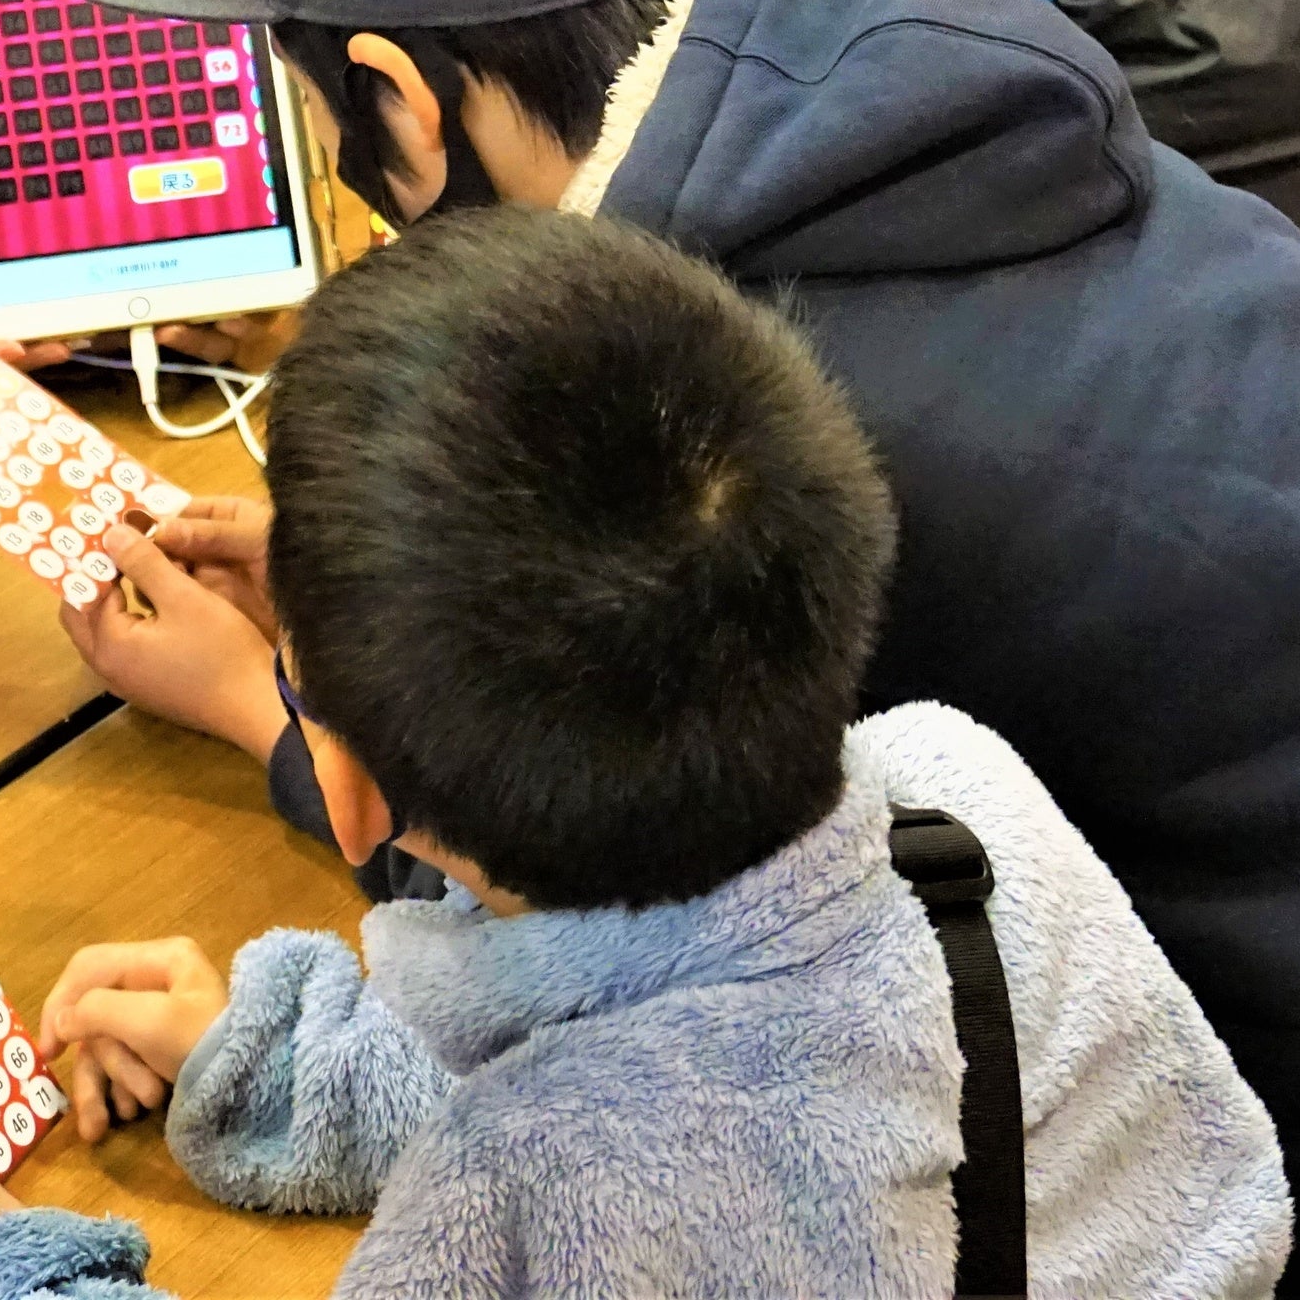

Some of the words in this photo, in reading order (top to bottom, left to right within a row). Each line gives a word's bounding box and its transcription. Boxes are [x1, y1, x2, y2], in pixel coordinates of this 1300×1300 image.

[222, 123, 242, 137] 72
[161, 173, 195, 191] 戻る
[15, 463, 33, 479] 38
[37, 442, 53, 456] 48
[56, 421, 73, 437] 73
[5, 532, 22, 547] 13
[27, 510, 43, 525] 18
[69, 466, 85, 480] 46
[89, 446, 104, 460] 71
[40, 559, 52, 569] 1
[58, 535, 75, 550] 21
[79, 511, 96, 526] 45
[100, 491, 117, 506] 53
[119, 469, 137, 484] 62
[71, 581, 87, 595] 10
[91, 559, 108, 575] 23
[10, 1046, 28, 1069] 66
[12, 1113, 28, 1133] 46
[35, 1086, 52, 1107] 71
